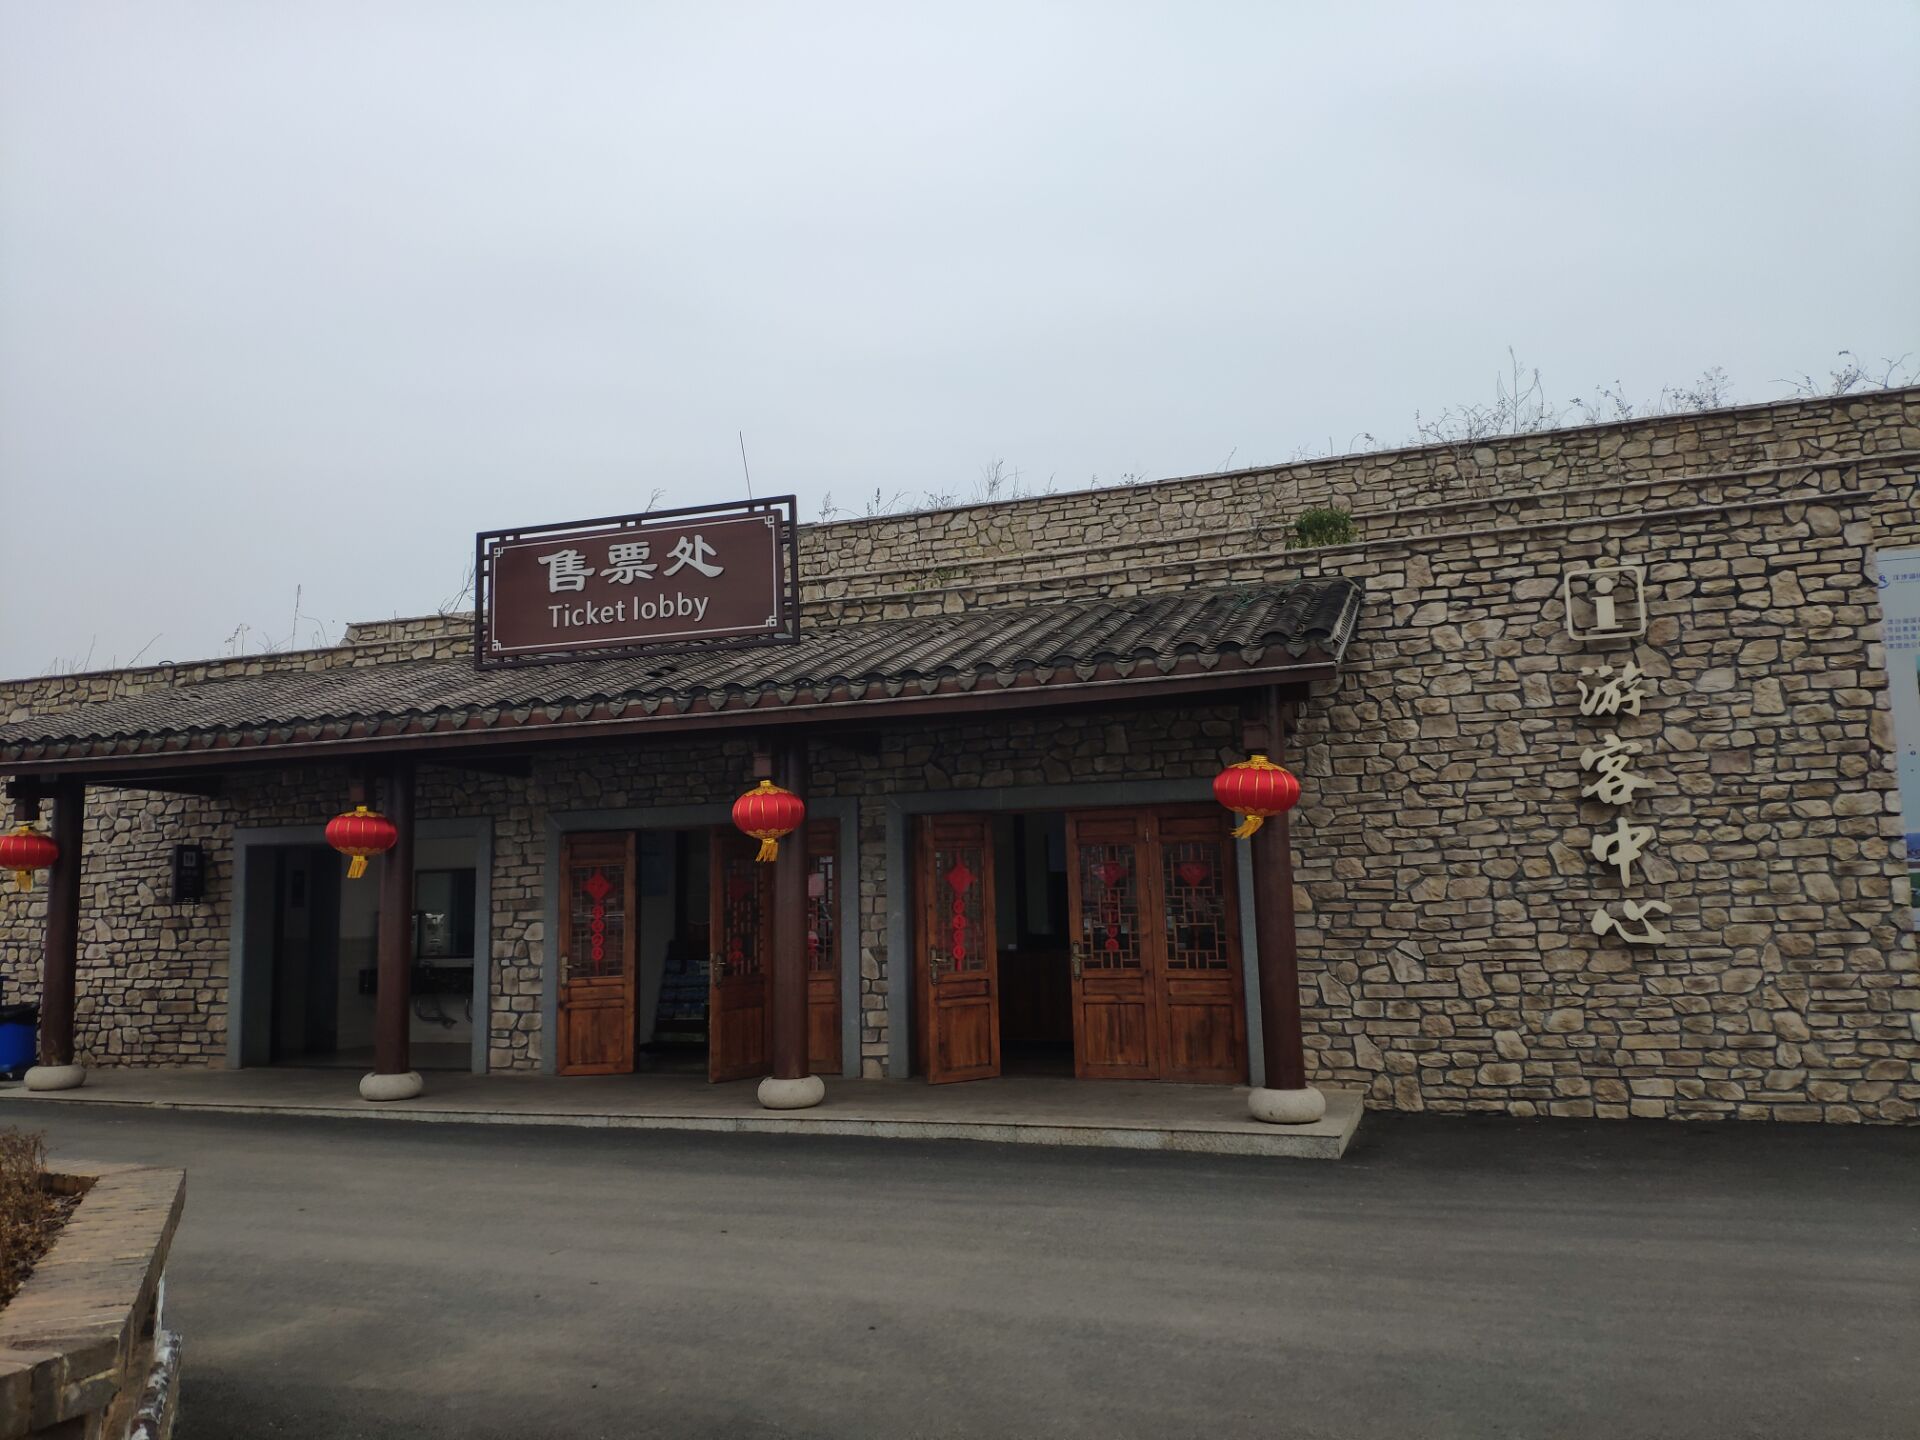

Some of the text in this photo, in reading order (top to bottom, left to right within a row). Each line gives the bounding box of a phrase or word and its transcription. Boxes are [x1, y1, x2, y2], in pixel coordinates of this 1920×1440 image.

[537, 534, 724, 593] 售票处
[548, 591, 710, 628] Ticket lobby
[1577, 660, 1673, 945] 游客中心
